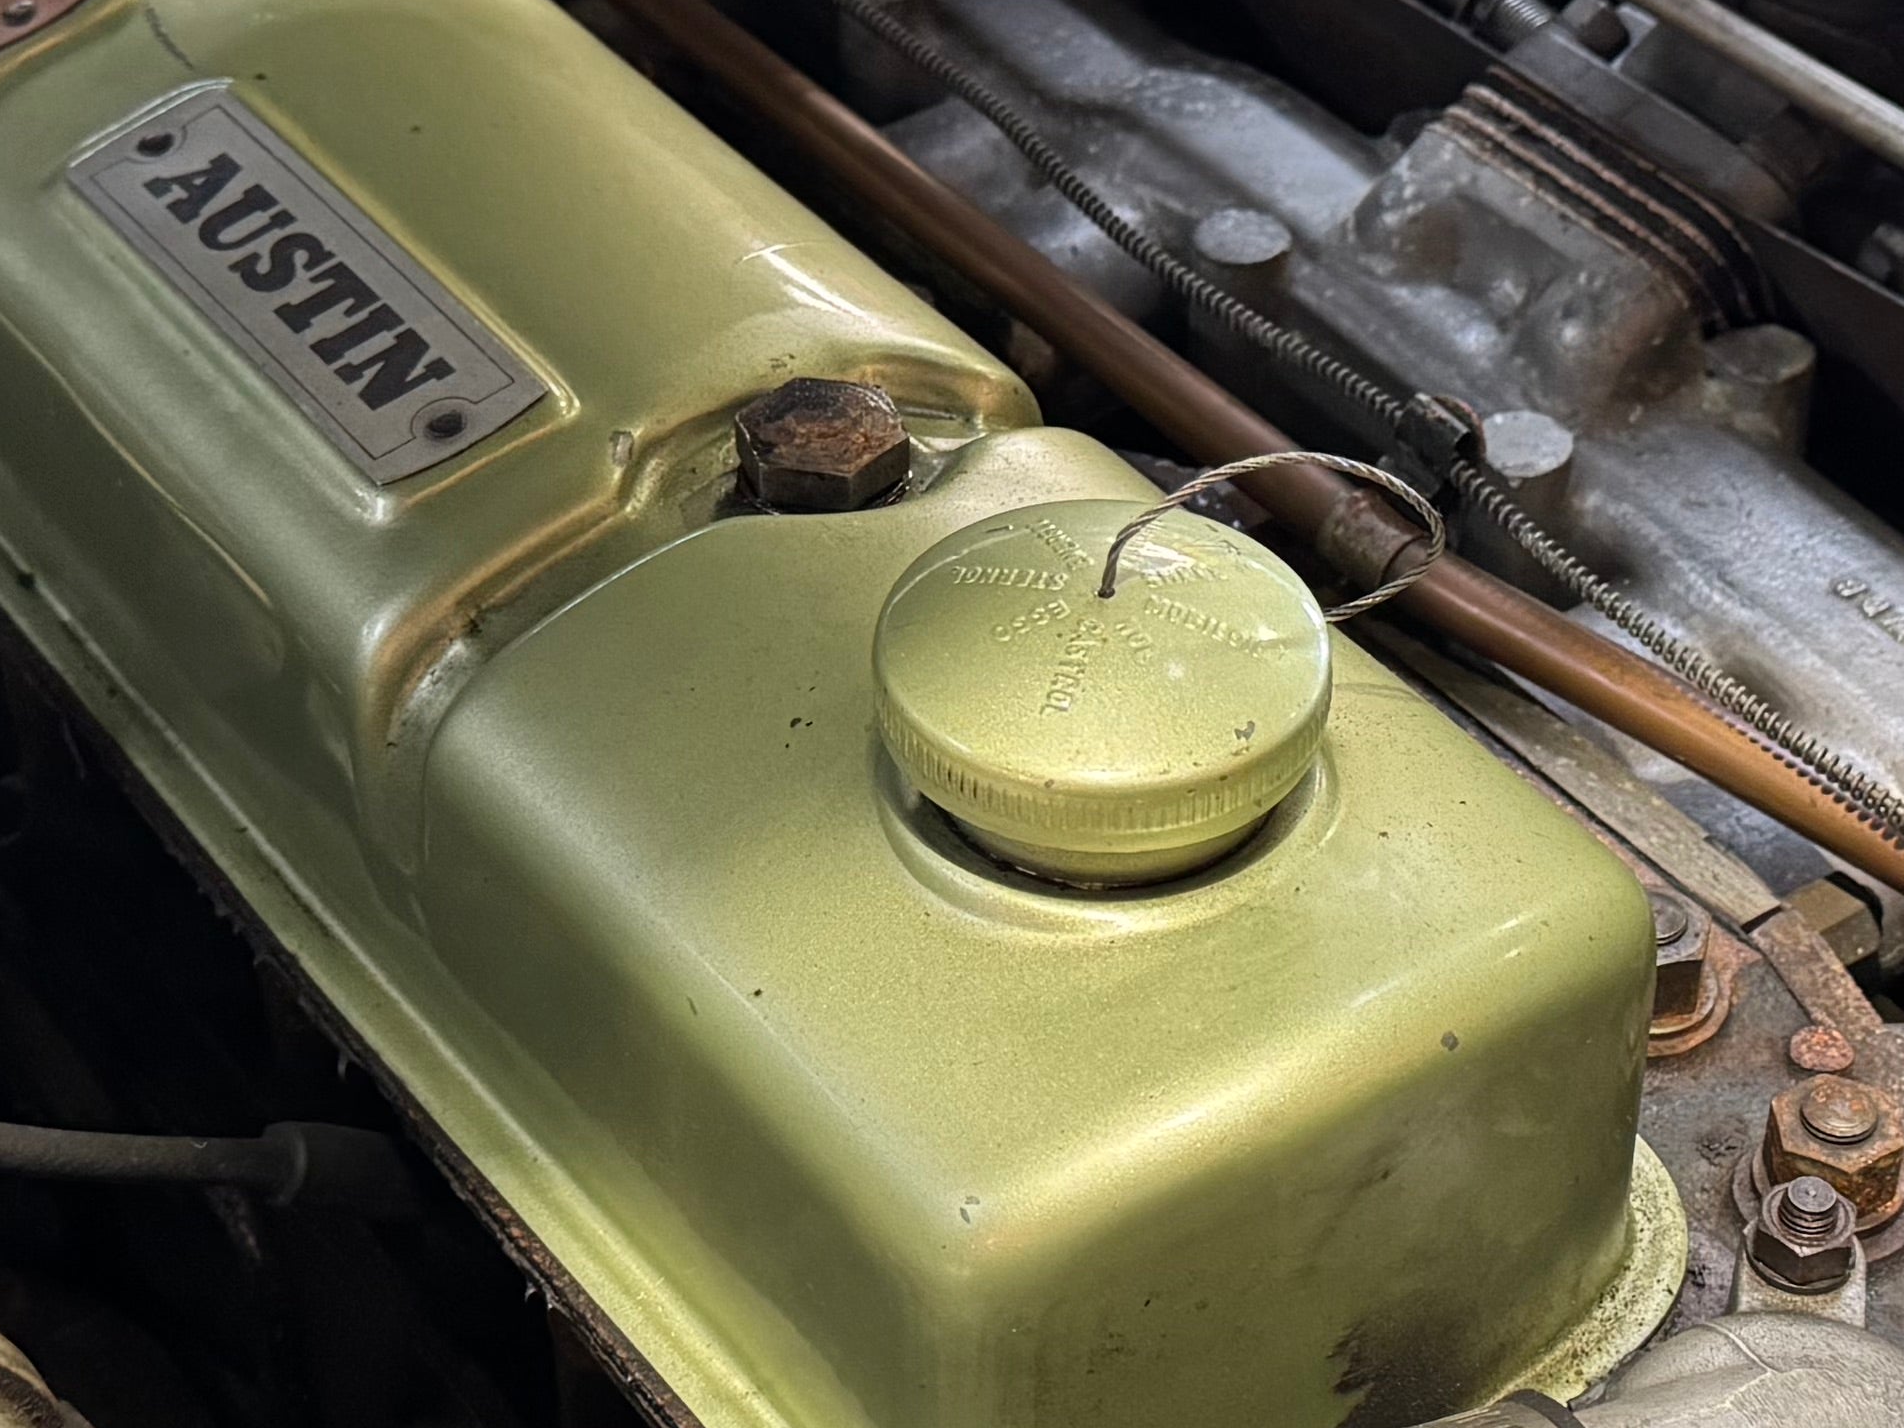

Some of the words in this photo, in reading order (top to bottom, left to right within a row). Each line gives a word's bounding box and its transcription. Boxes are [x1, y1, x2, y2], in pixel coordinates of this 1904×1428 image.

[143, 152, 456, 412] AUSTIN
[953, 565, 1069, 591] STERNOL
[992, 599, 1071, 642] ESSO
